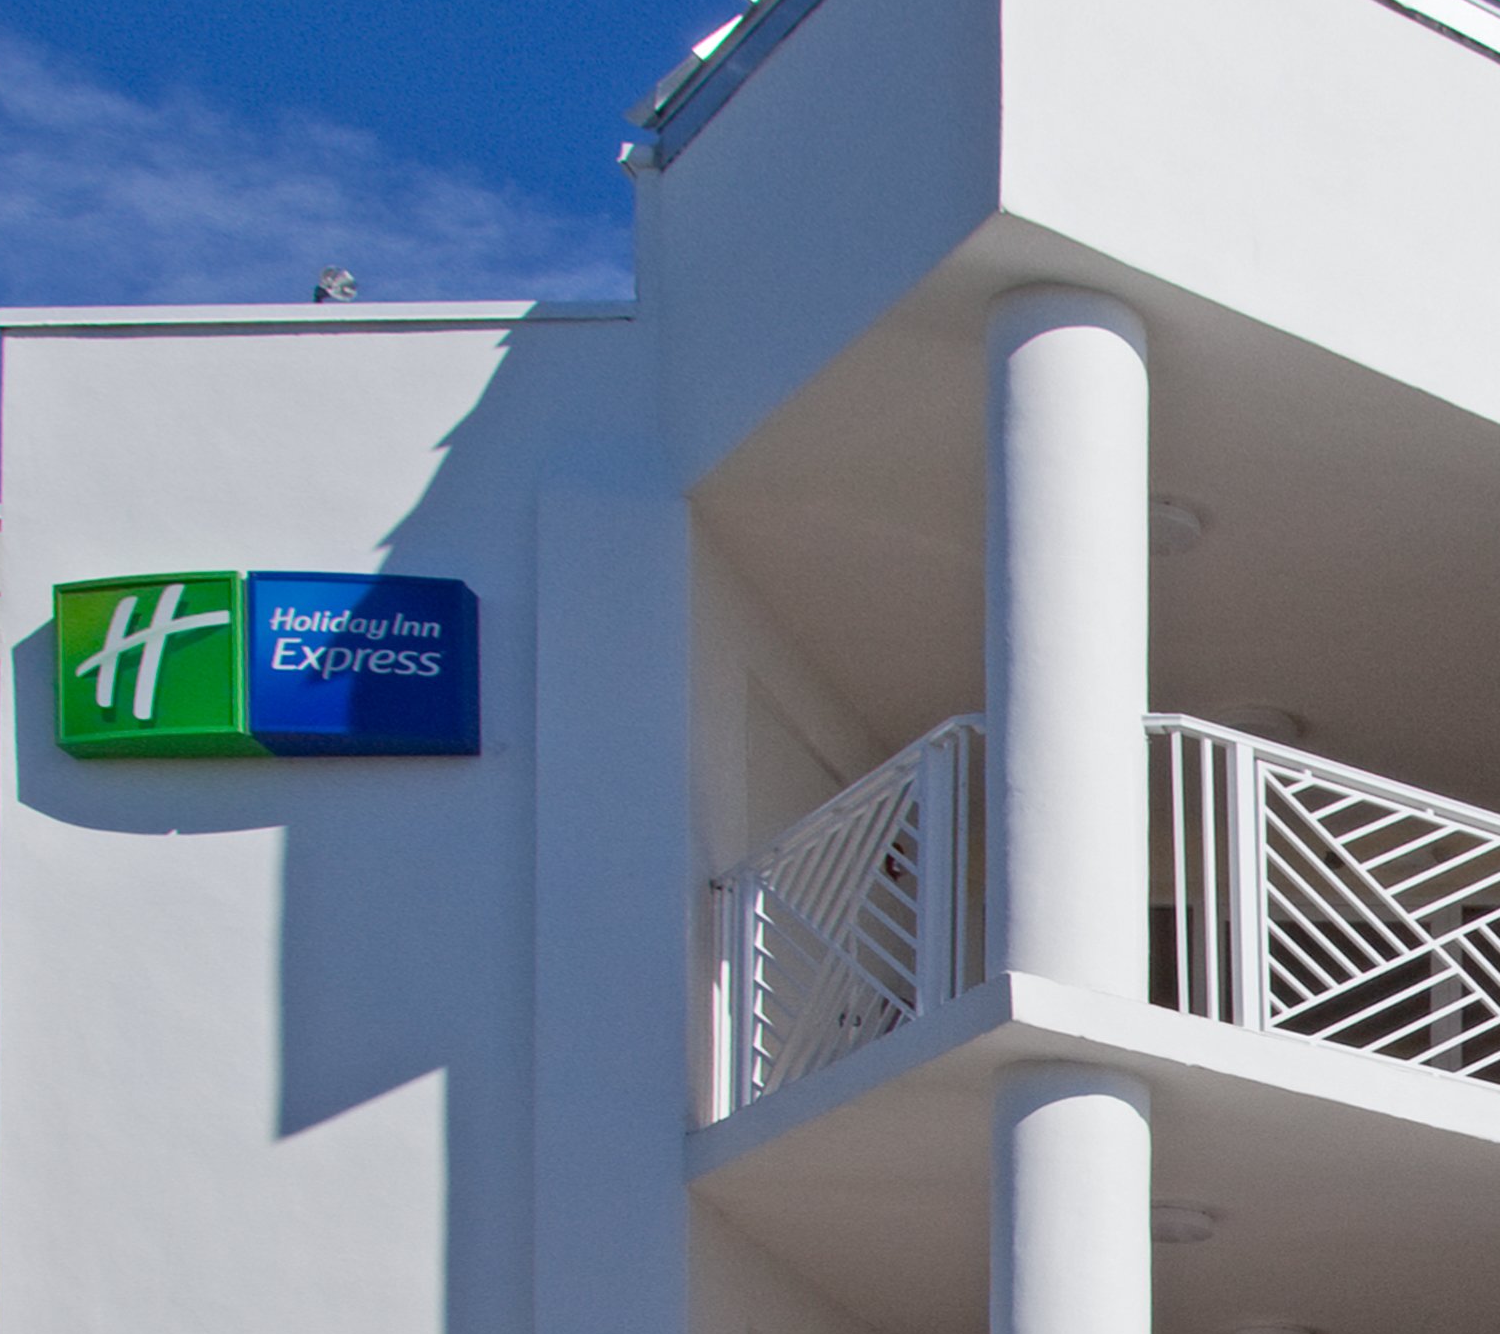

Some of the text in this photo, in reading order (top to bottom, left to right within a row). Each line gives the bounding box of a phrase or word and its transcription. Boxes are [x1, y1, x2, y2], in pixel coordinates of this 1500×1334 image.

[269, 606, 442, 640] Holiday Inn
[271, 637, 442, 680] Express
